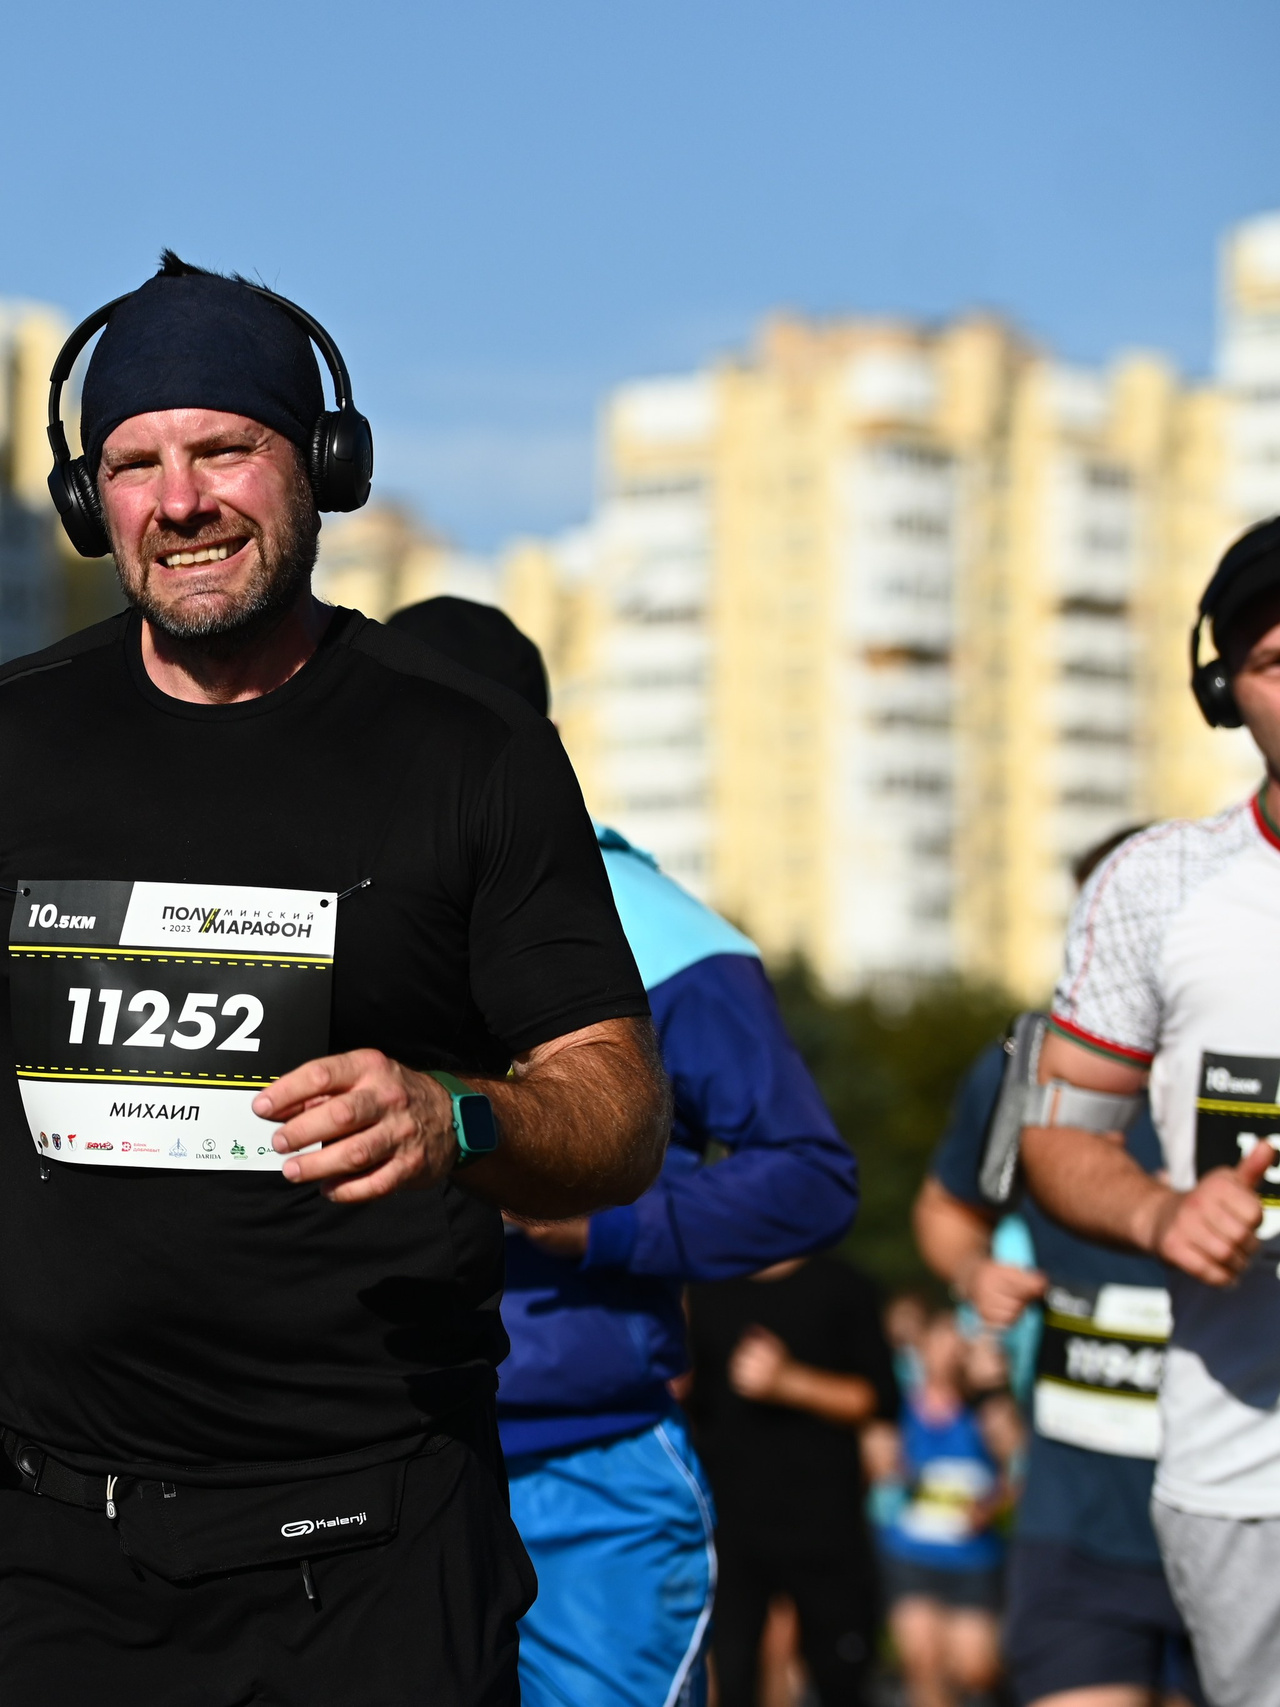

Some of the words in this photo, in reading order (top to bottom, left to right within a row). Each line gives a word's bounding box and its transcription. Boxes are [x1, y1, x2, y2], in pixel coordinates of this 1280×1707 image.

[224, 909, 314, 921] МИНСКИЙ
[169, 924, 191, 933] 2023
[206, 917, 312, 938] МАРАФОН
[67, 987, 265, 1052] 11252
[109, 1102, 200, 1122] МИХАИЛ
[316, 1511, 366, 1529] Kalenji
